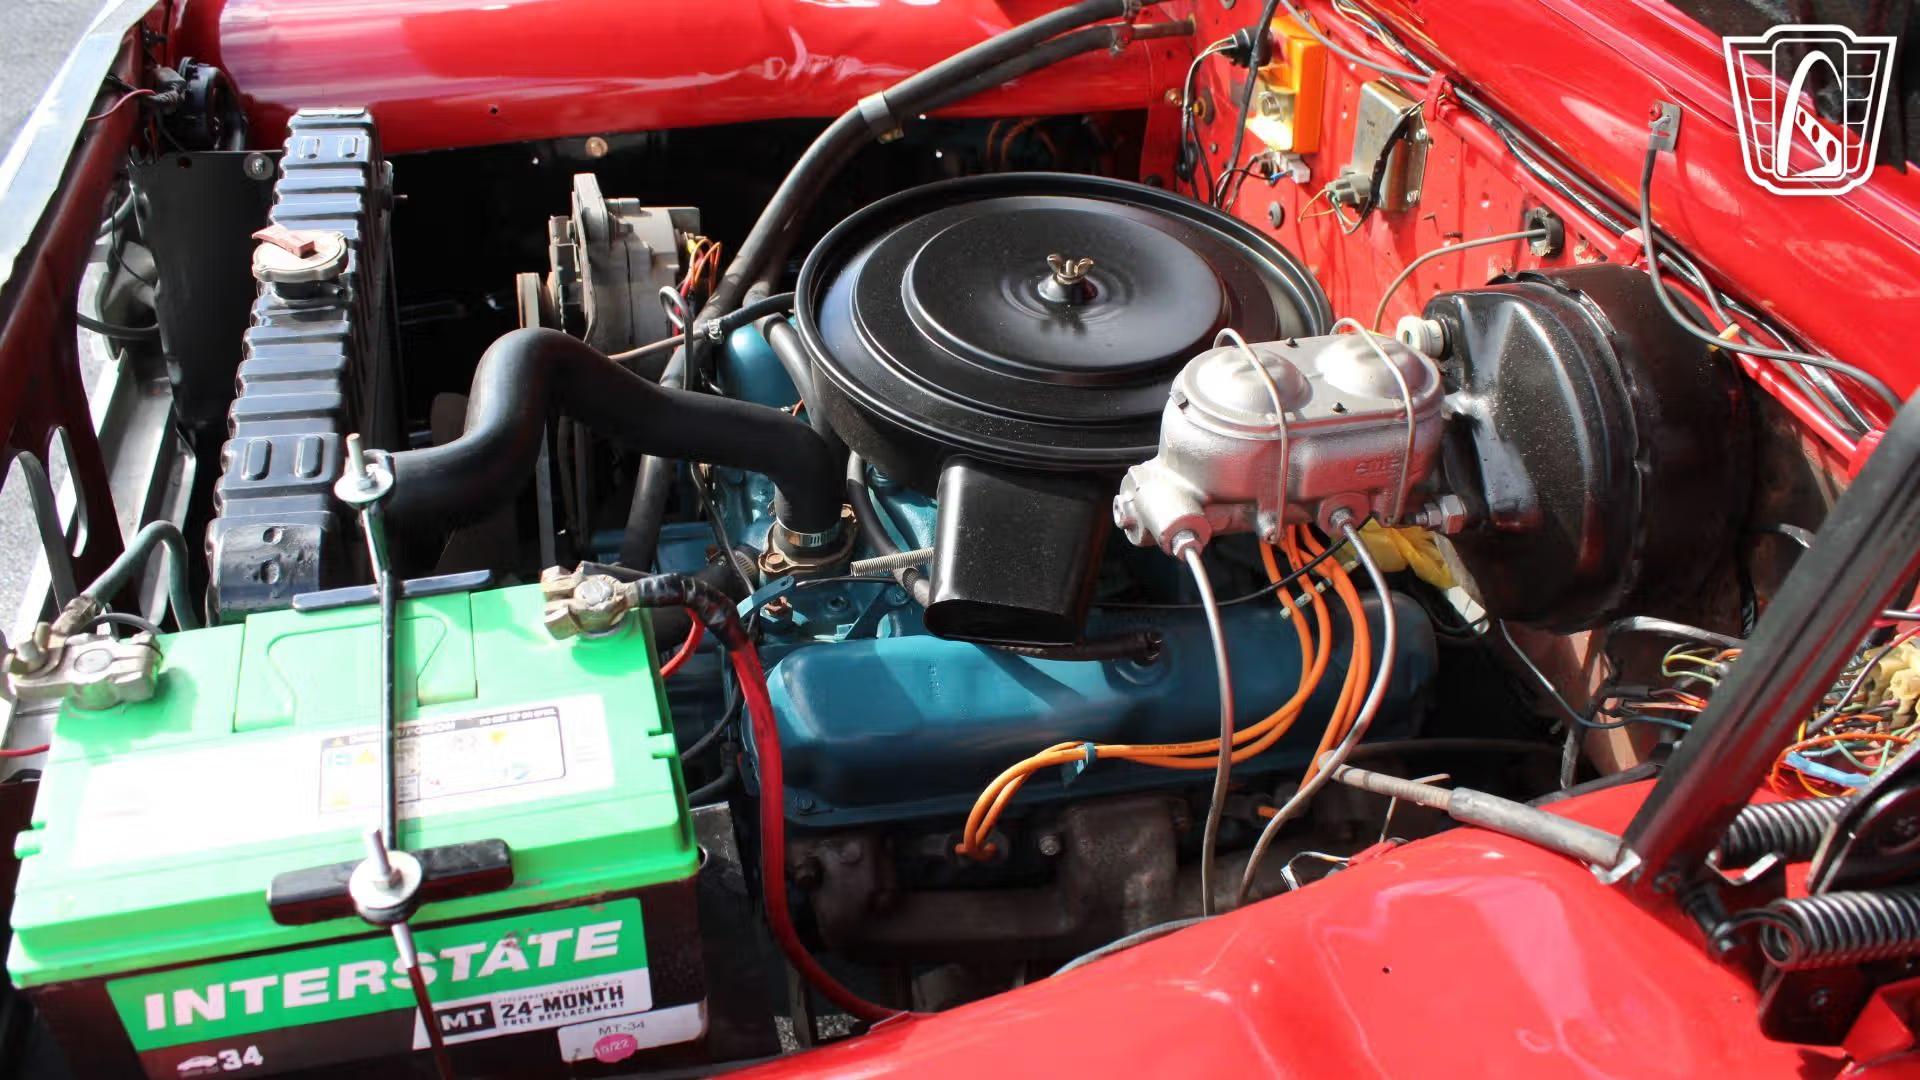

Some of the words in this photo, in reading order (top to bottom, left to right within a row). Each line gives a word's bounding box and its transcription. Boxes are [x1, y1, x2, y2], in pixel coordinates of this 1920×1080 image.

[145, 920, 623, 1031] INTERSTATE
[500, 985, 624, 1018] 24-MONTH
[503, 1016, 532, 1027] FREE
[538, 1001, 625, 1021] REPLACEMENT
[441, 1009, 487, 1031] MT
[598, 1020, 645, 1035] MT-34
[217, 1045, 264, 1071] 34
